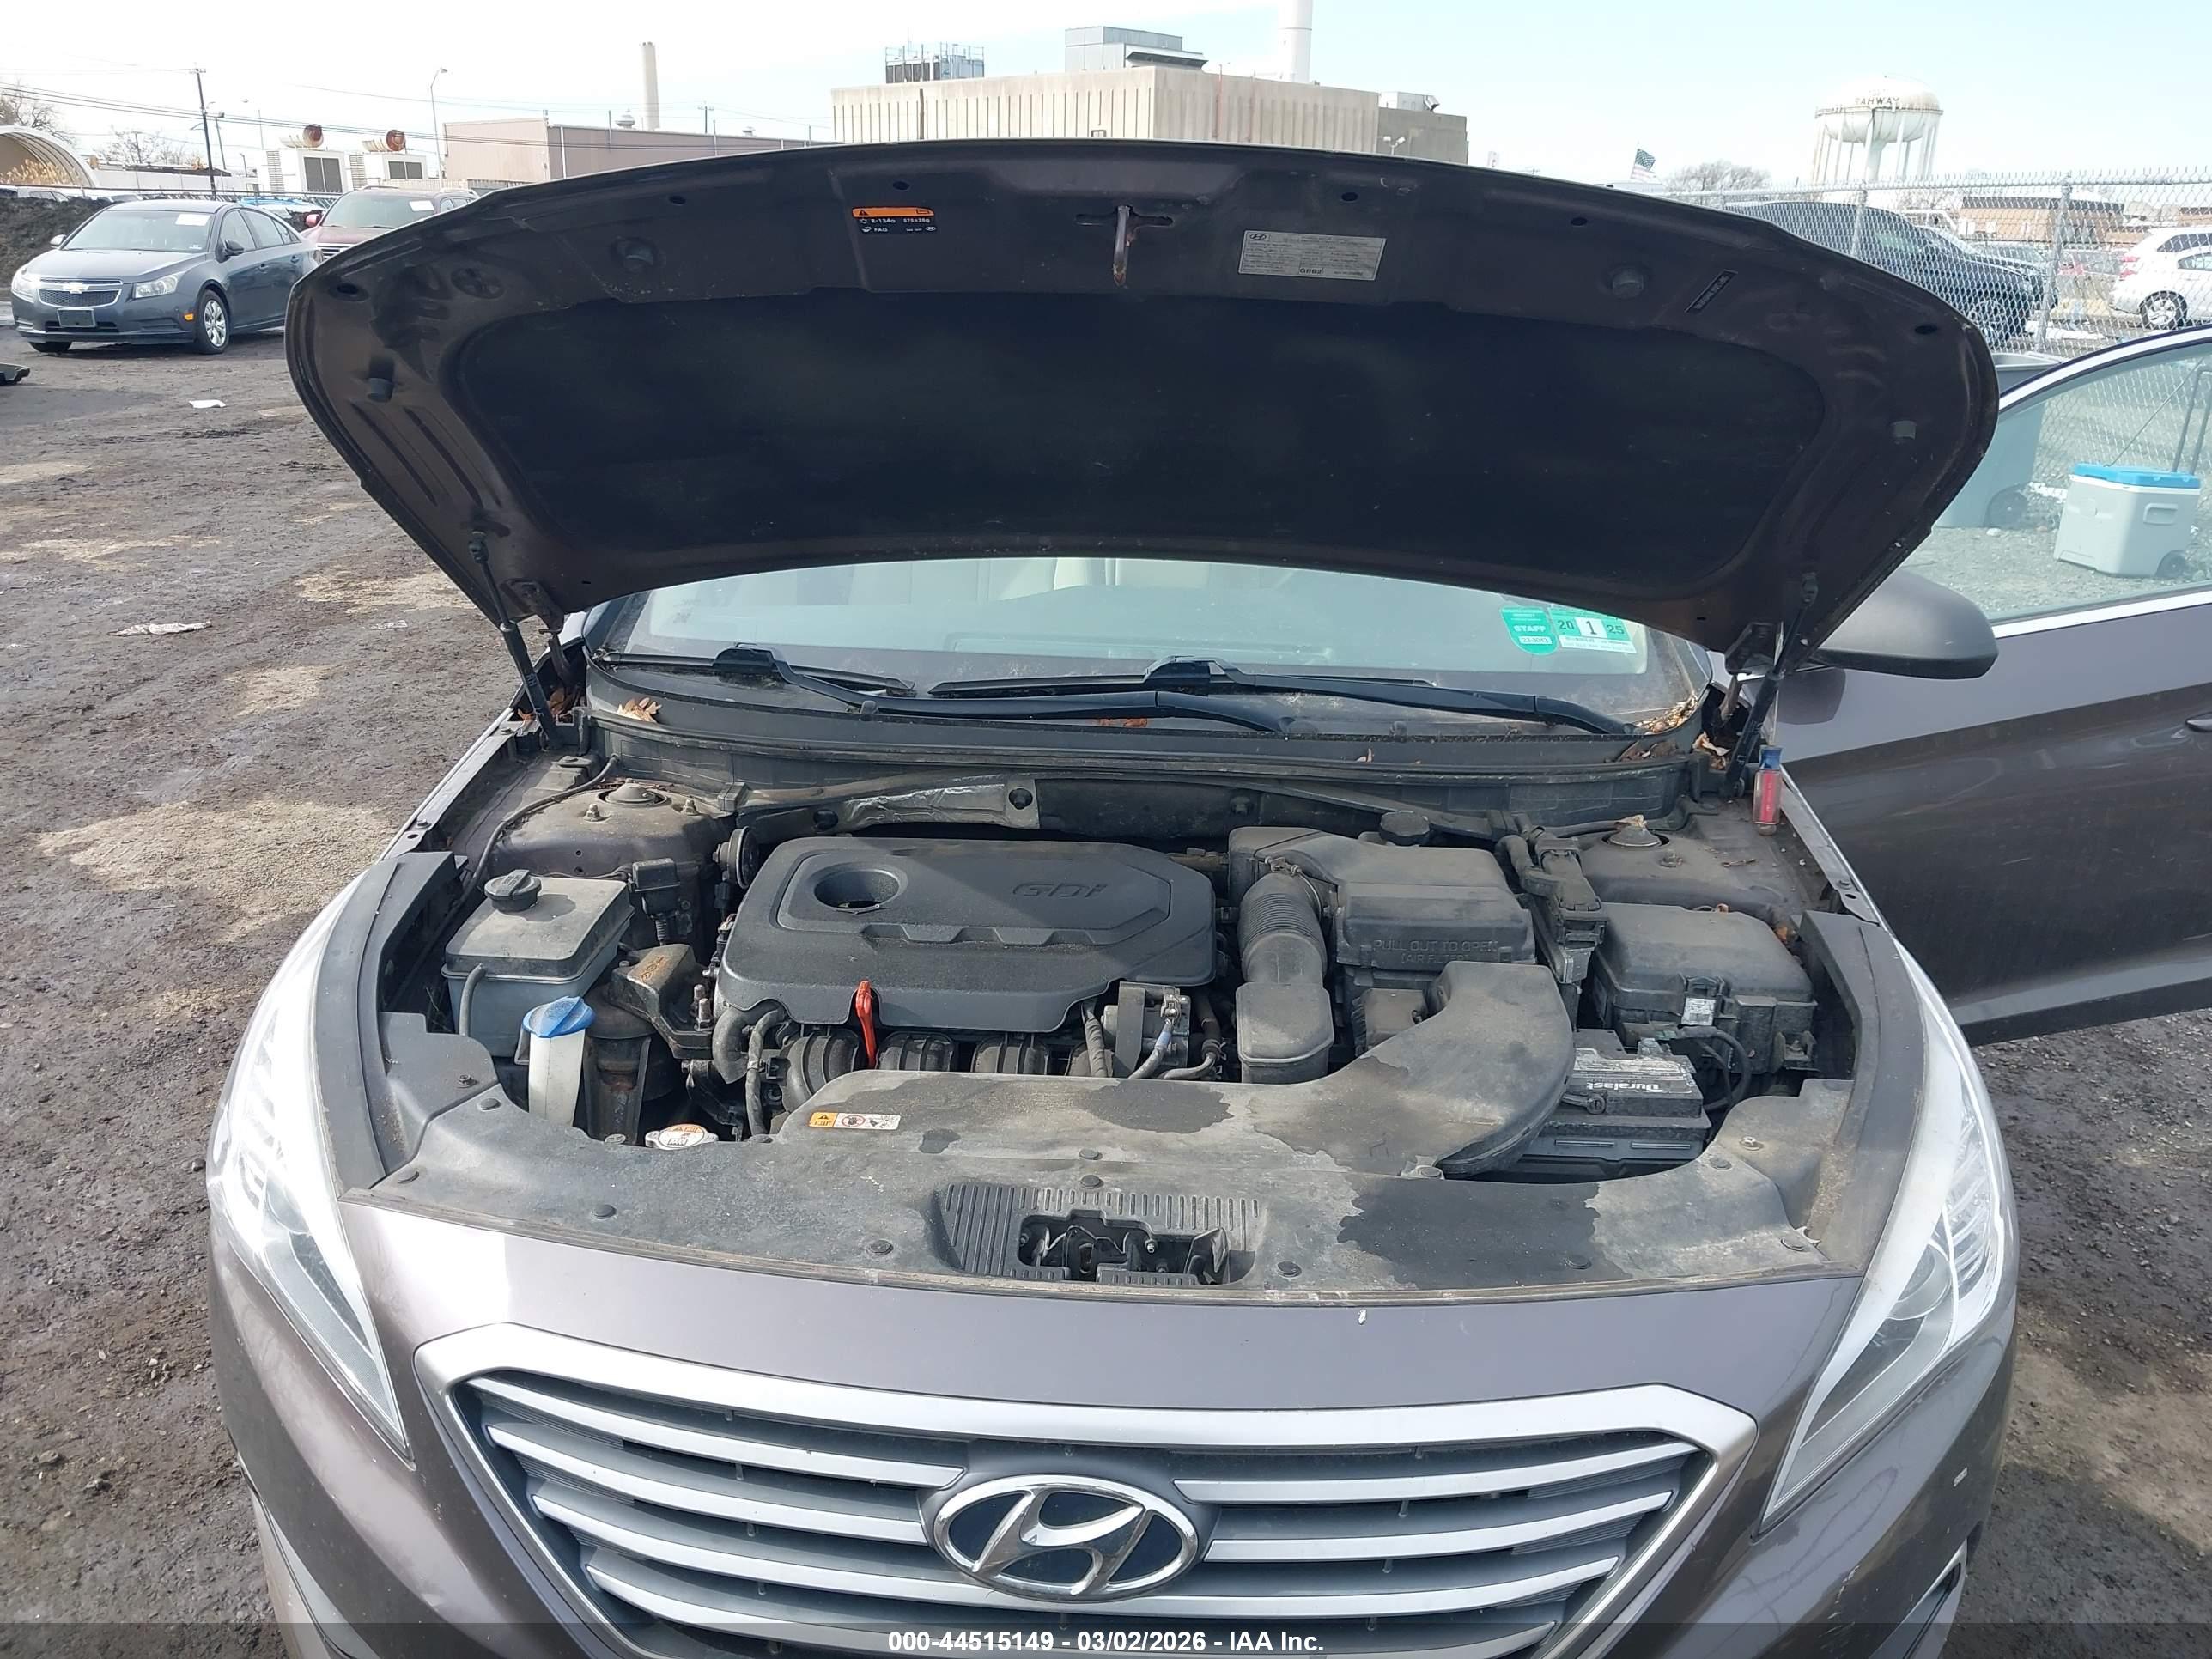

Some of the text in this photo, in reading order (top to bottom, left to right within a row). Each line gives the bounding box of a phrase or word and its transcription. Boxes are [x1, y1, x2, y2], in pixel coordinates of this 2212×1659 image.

[1558, 620, 1625, 639] 20 1 25
[1373, 939, 1499, 952] PULL OUT TO OPEN
[1587, 1081, 1663, 1091] Duralast
